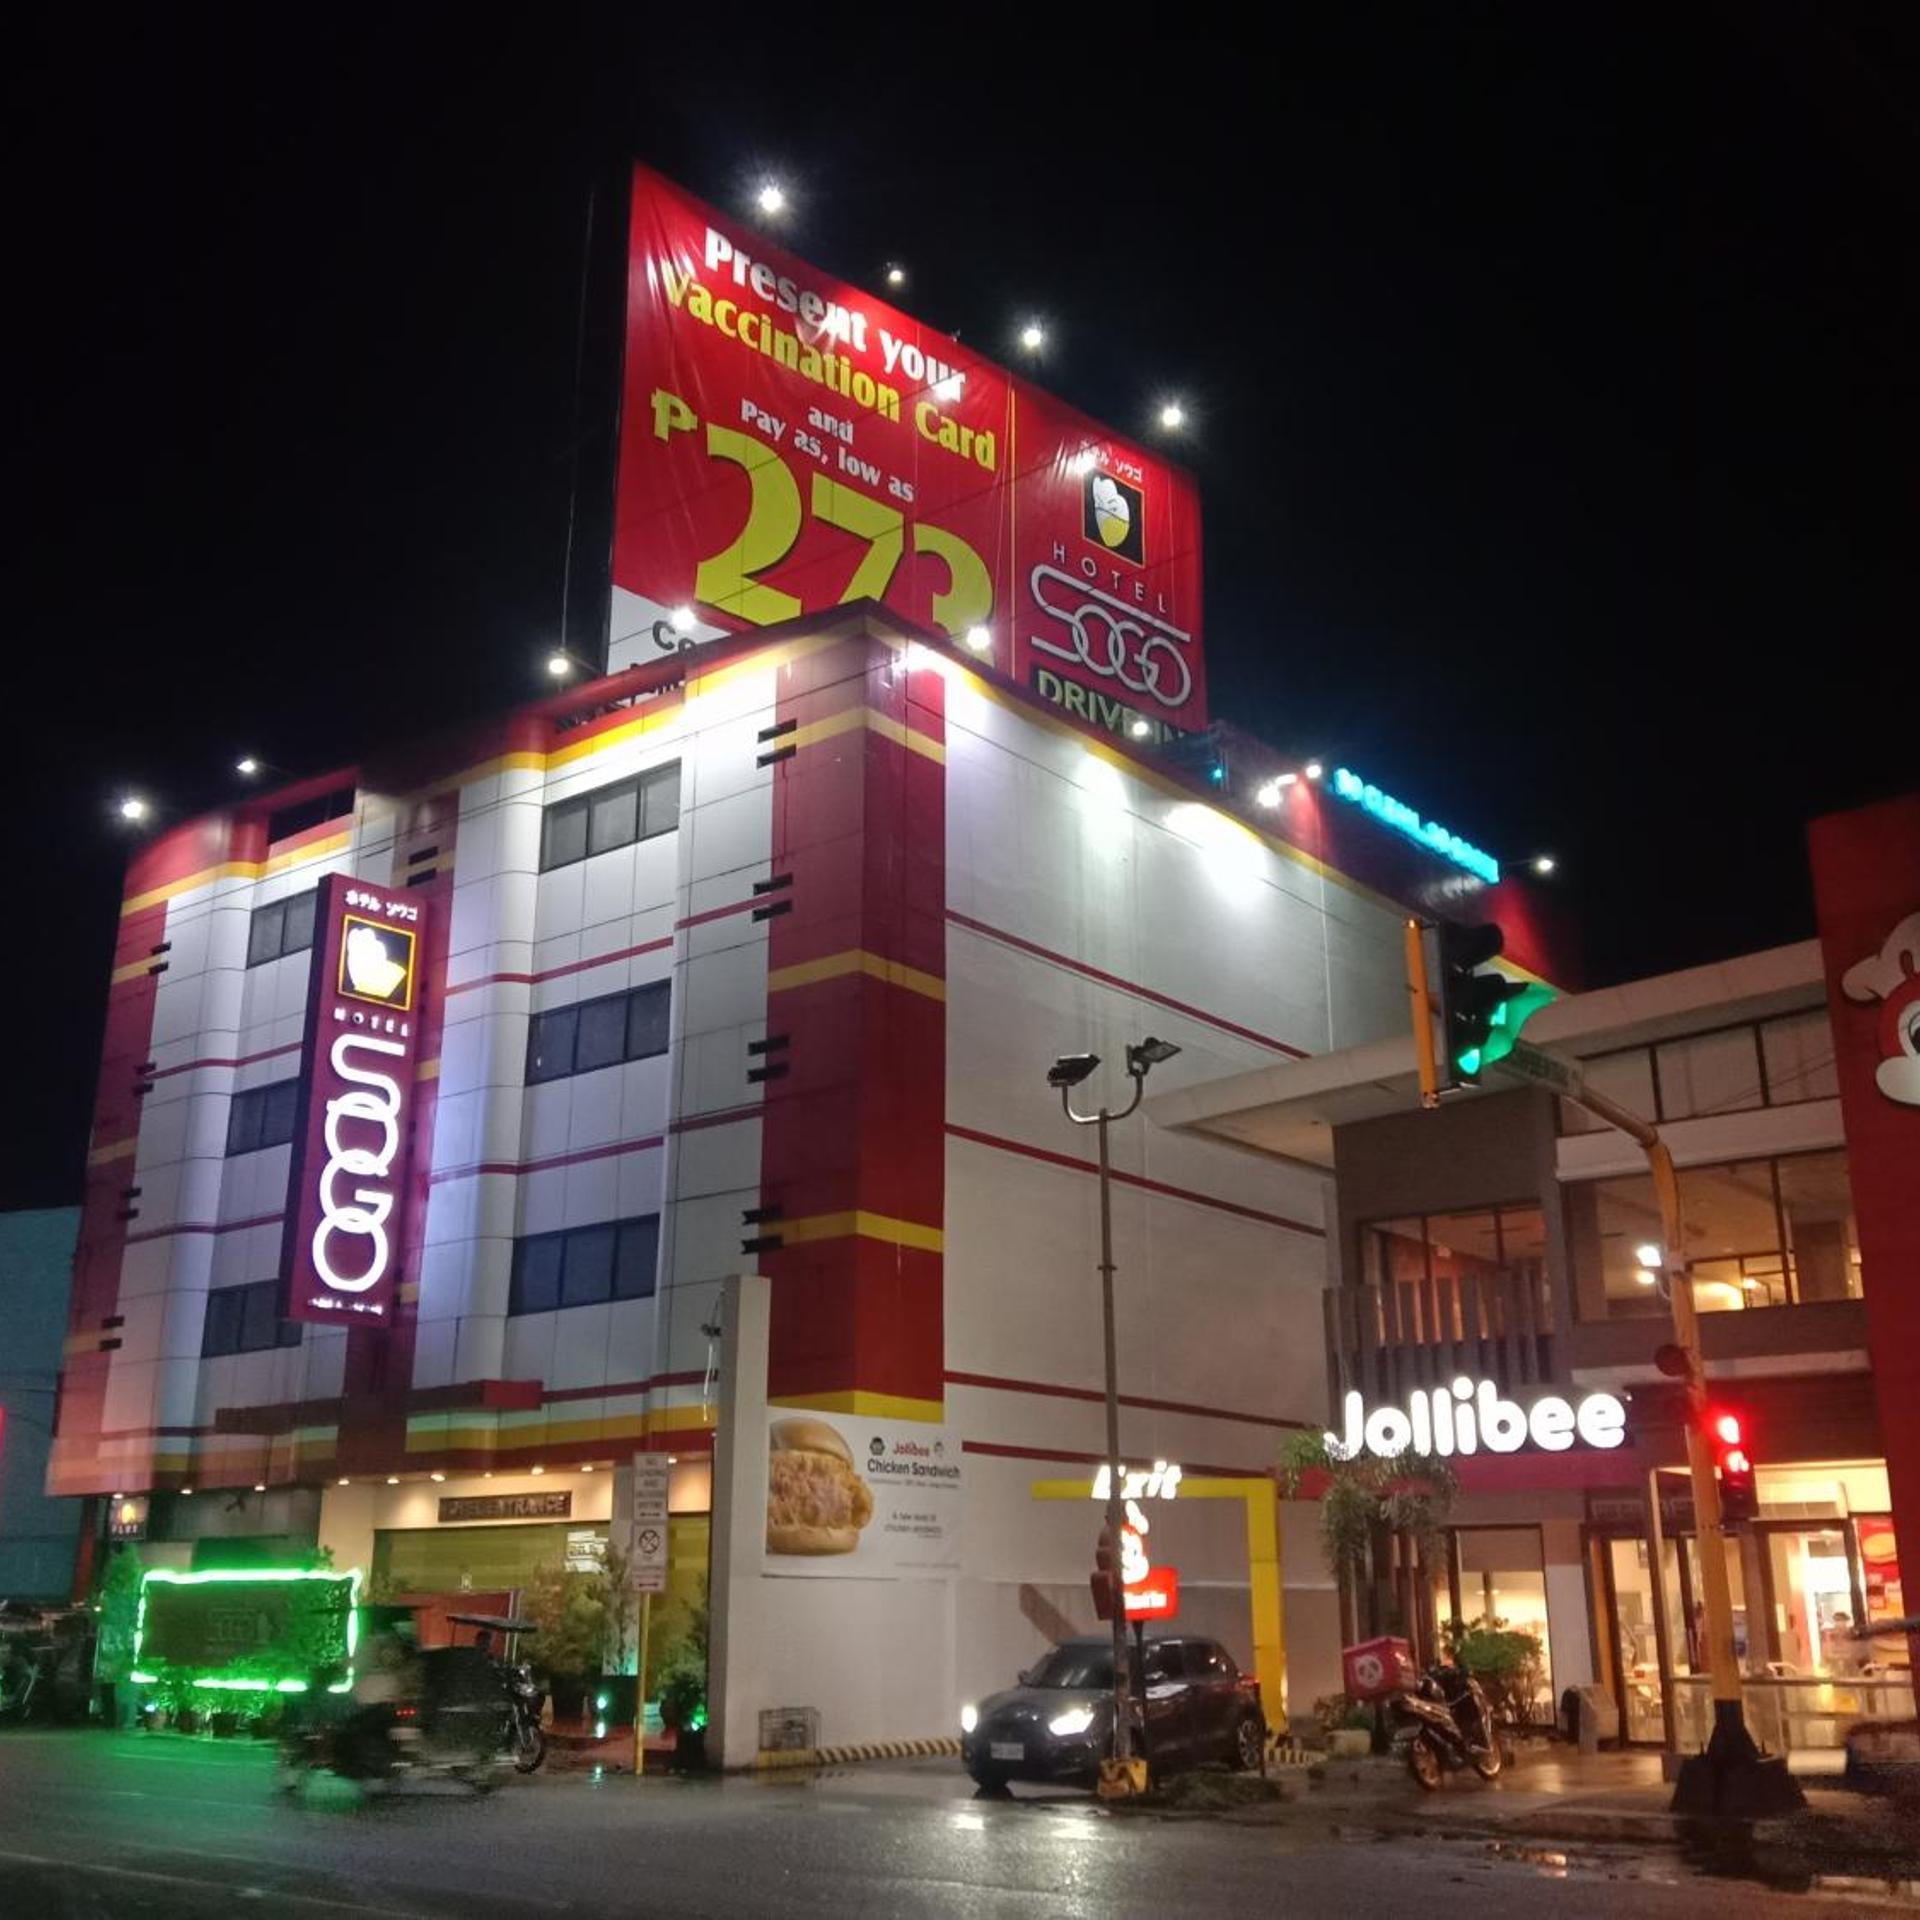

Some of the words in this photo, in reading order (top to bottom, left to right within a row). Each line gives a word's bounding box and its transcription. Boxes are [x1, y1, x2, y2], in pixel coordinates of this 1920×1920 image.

[661, 257, 899, 424] Vaccination
[915, 401, 995, 472] Card
[706, 227, 867, 352] Present
[879, 328, 966, 403] your
[741, 398, 785, 441] Pay
[838, 446, 880, 486] low
[889, 474, 914, 502] as
[808, 406, 853, 445] and
[695, 423, 993, 656] 273
[1053, 540, 1167, 613] HOTEL
[1031, 564, 1191, 706] SOGO
[334, 1007, 409, 1037] HOTEL
[312, 1033, 406, 1292] SOGO
[867, 1458, 909, 1475] Chicken
[912, 1462, 960, 1478] Sandwich
[1323, 1377, 1625, 1461] Jollibee
